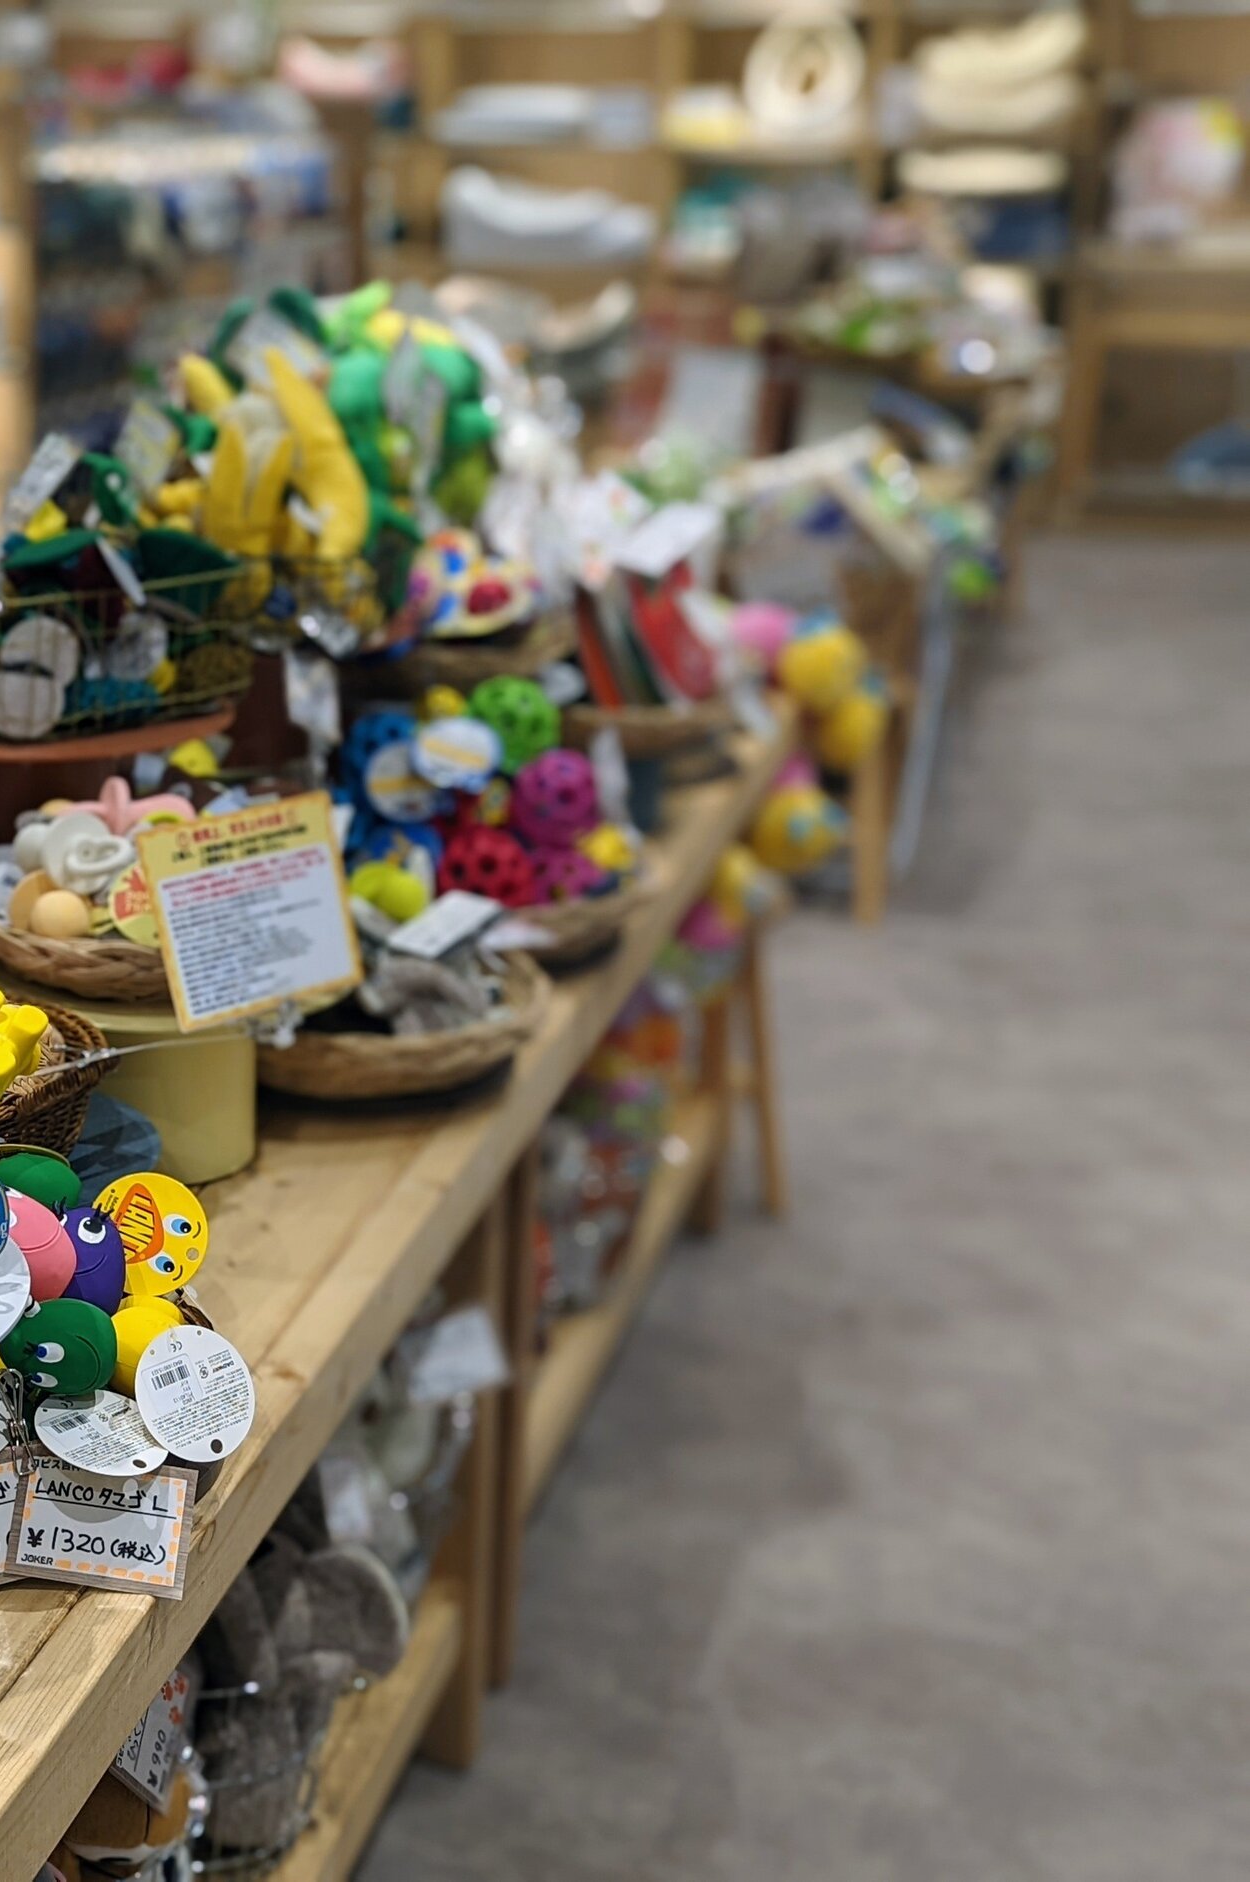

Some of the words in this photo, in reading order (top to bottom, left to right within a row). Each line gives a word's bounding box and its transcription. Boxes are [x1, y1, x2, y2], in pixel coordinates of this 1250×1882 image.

[118, 1191, 155, 1261] LANC
[35, 1478, 94, 1501] LANCO
[99, 1488, 147, 1509] タマゴ
[152, 1495, 168, 1512] L
[20, 1553, 54, 1566] JOKER
[27, 1527, 45, 1548] ¥
[51, 1526, 105, 1555] 1320
[110, 1538, 166, 1565] (税込)
[151, 1729, 167, 1766] 990
